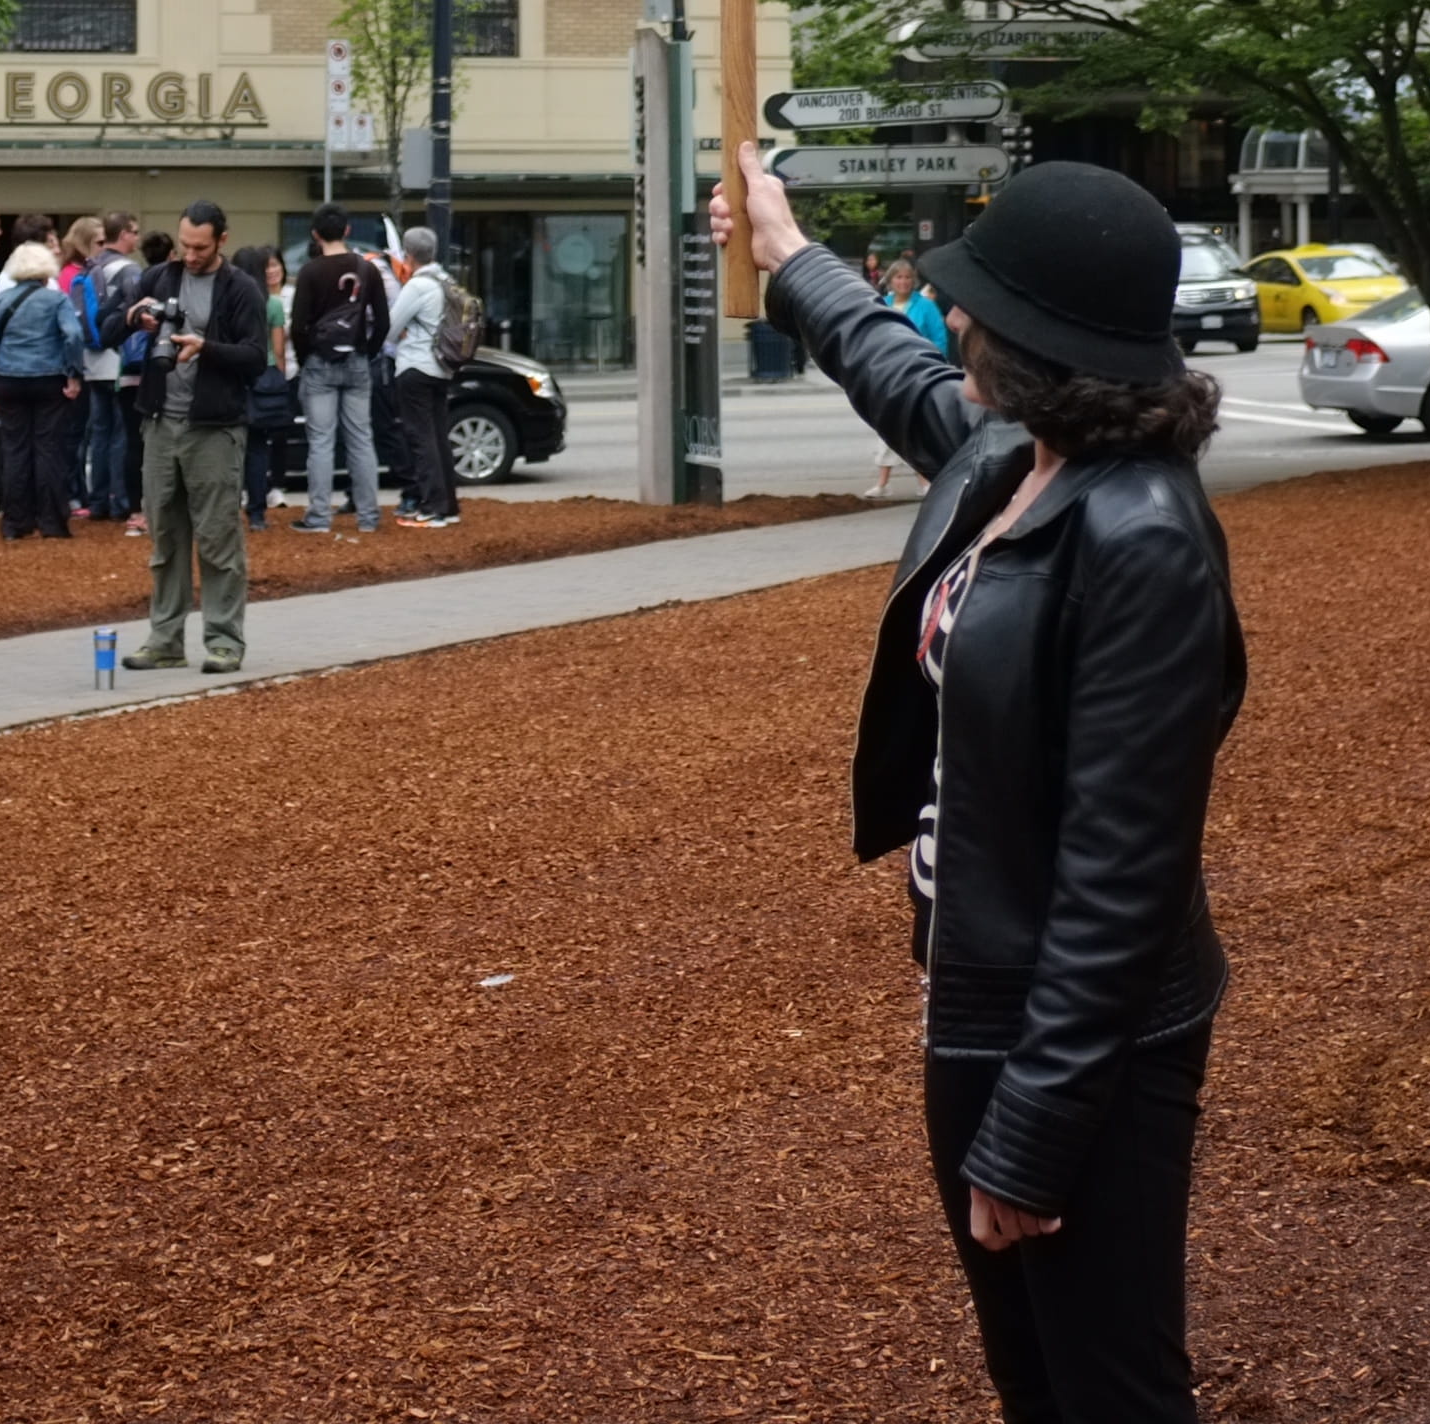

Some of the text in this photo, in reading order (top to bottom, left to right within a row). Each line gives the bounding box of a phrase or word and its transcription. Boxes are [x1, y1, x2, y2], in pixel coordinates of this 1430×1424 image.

[796, 93, 863, 108] VANCOUVER
[838, 106, 860, 121] 200
[866, 103, 922, 120] BURRARD
[839, 156, 956, 174] STANLEY PARK
